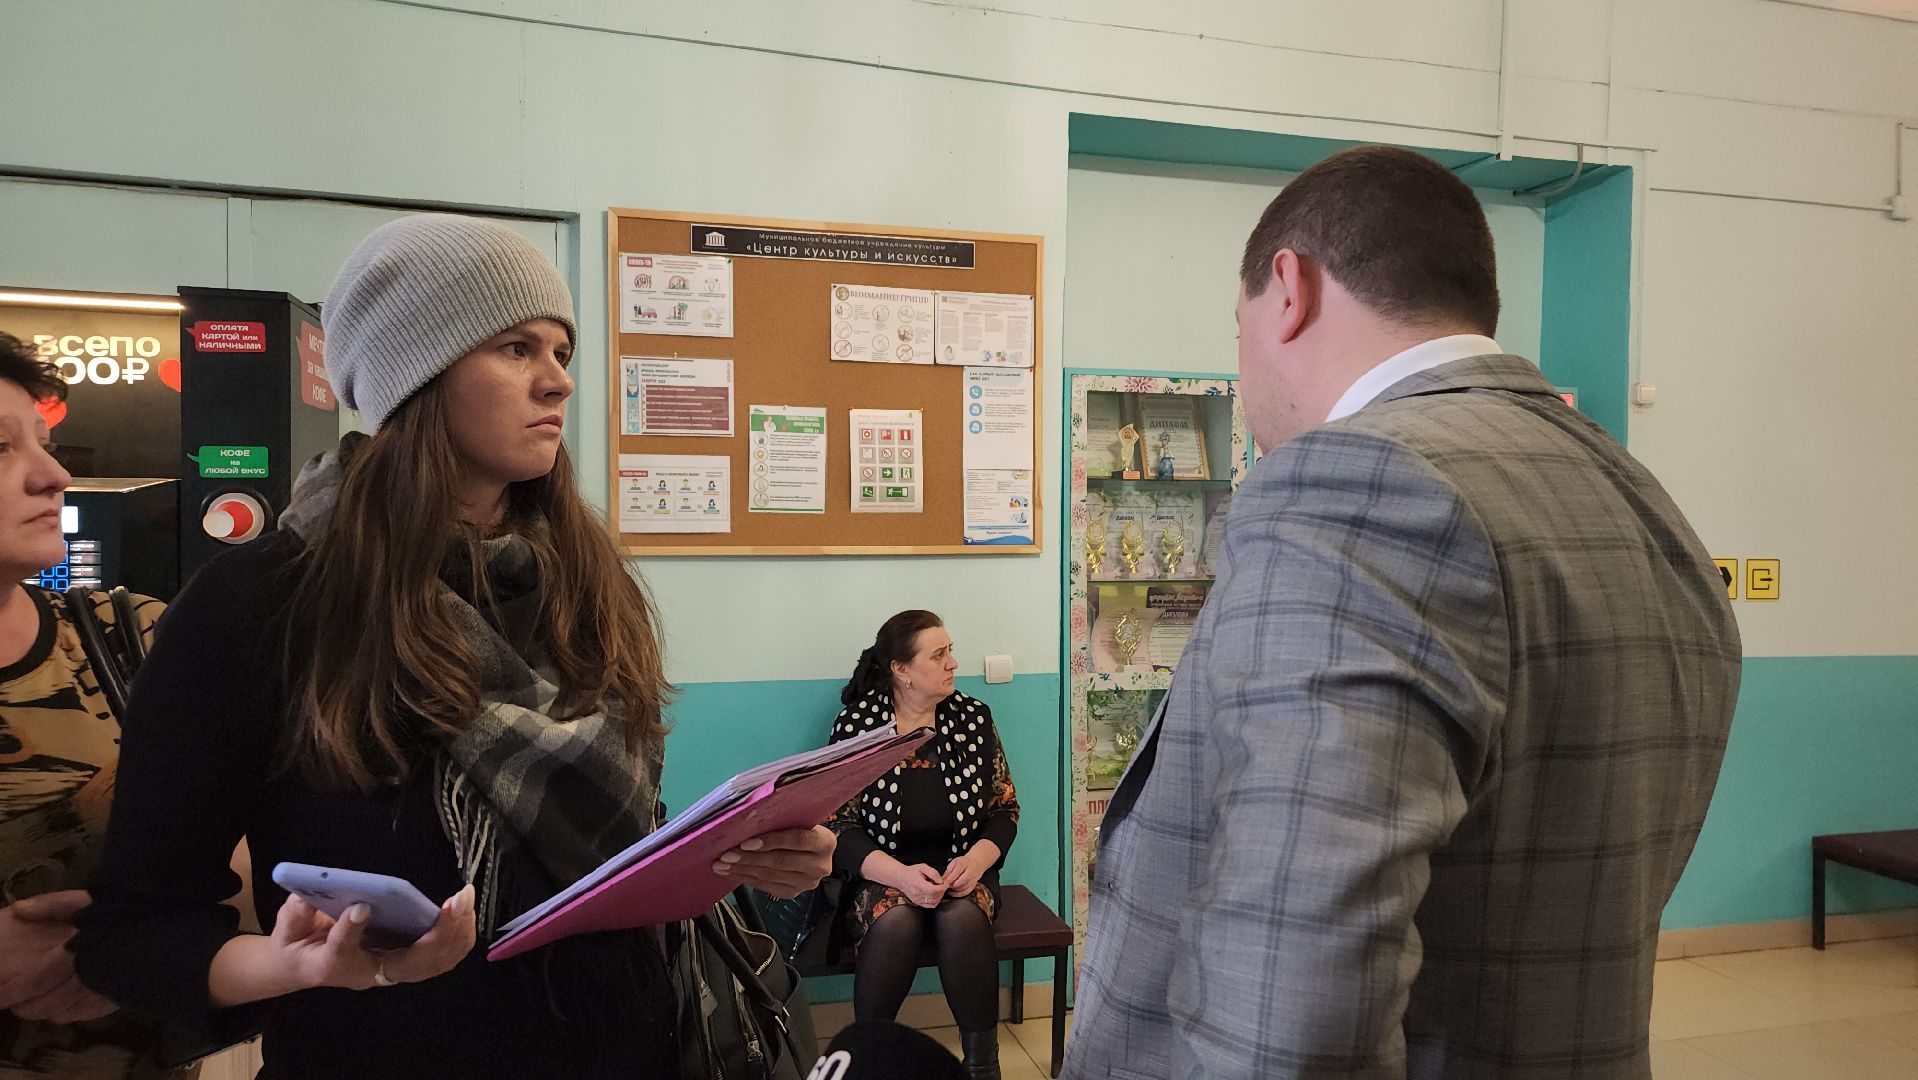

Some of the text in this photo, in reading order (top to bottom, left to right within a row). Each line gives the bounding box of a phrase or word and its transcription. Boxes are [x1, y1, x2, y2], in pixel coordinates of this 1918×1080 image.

[746, 241, 957, 264] «Центр культуры и искусств»
[210, 324, 249, 332] ОПЛАТА
[201, 332, 240, 342] КАРТОЙ
[199, 341, 262, 350] НАЛИЧНЫМИ
[220, 449, 250, 457] КОФЕ
